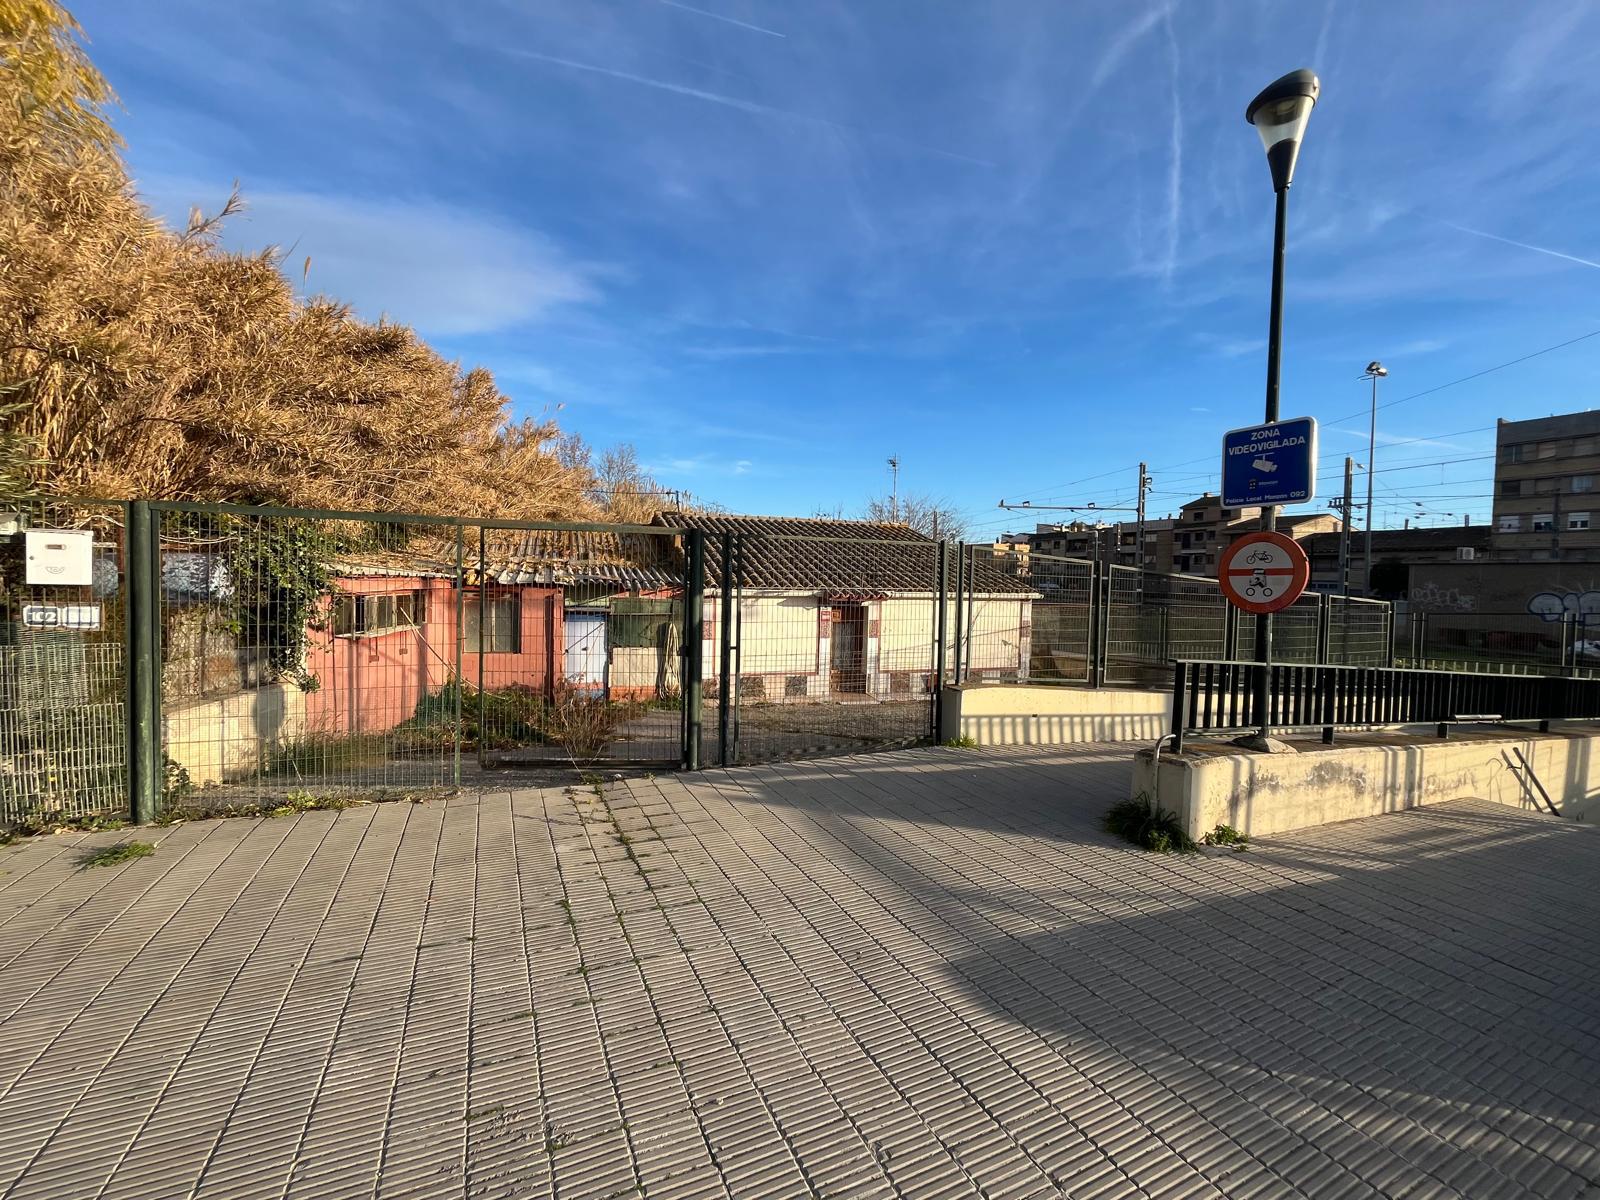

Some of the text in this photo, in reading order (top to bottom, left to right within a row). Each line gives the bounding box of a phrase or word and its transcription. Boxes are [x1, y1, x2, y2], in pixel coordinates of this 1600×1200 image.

[1251, 428, 1280, 440] ZONA
[1228, 436, 1306, 455] VIDEOVIGILADA
[1290, 490, 1306, 498] 092
